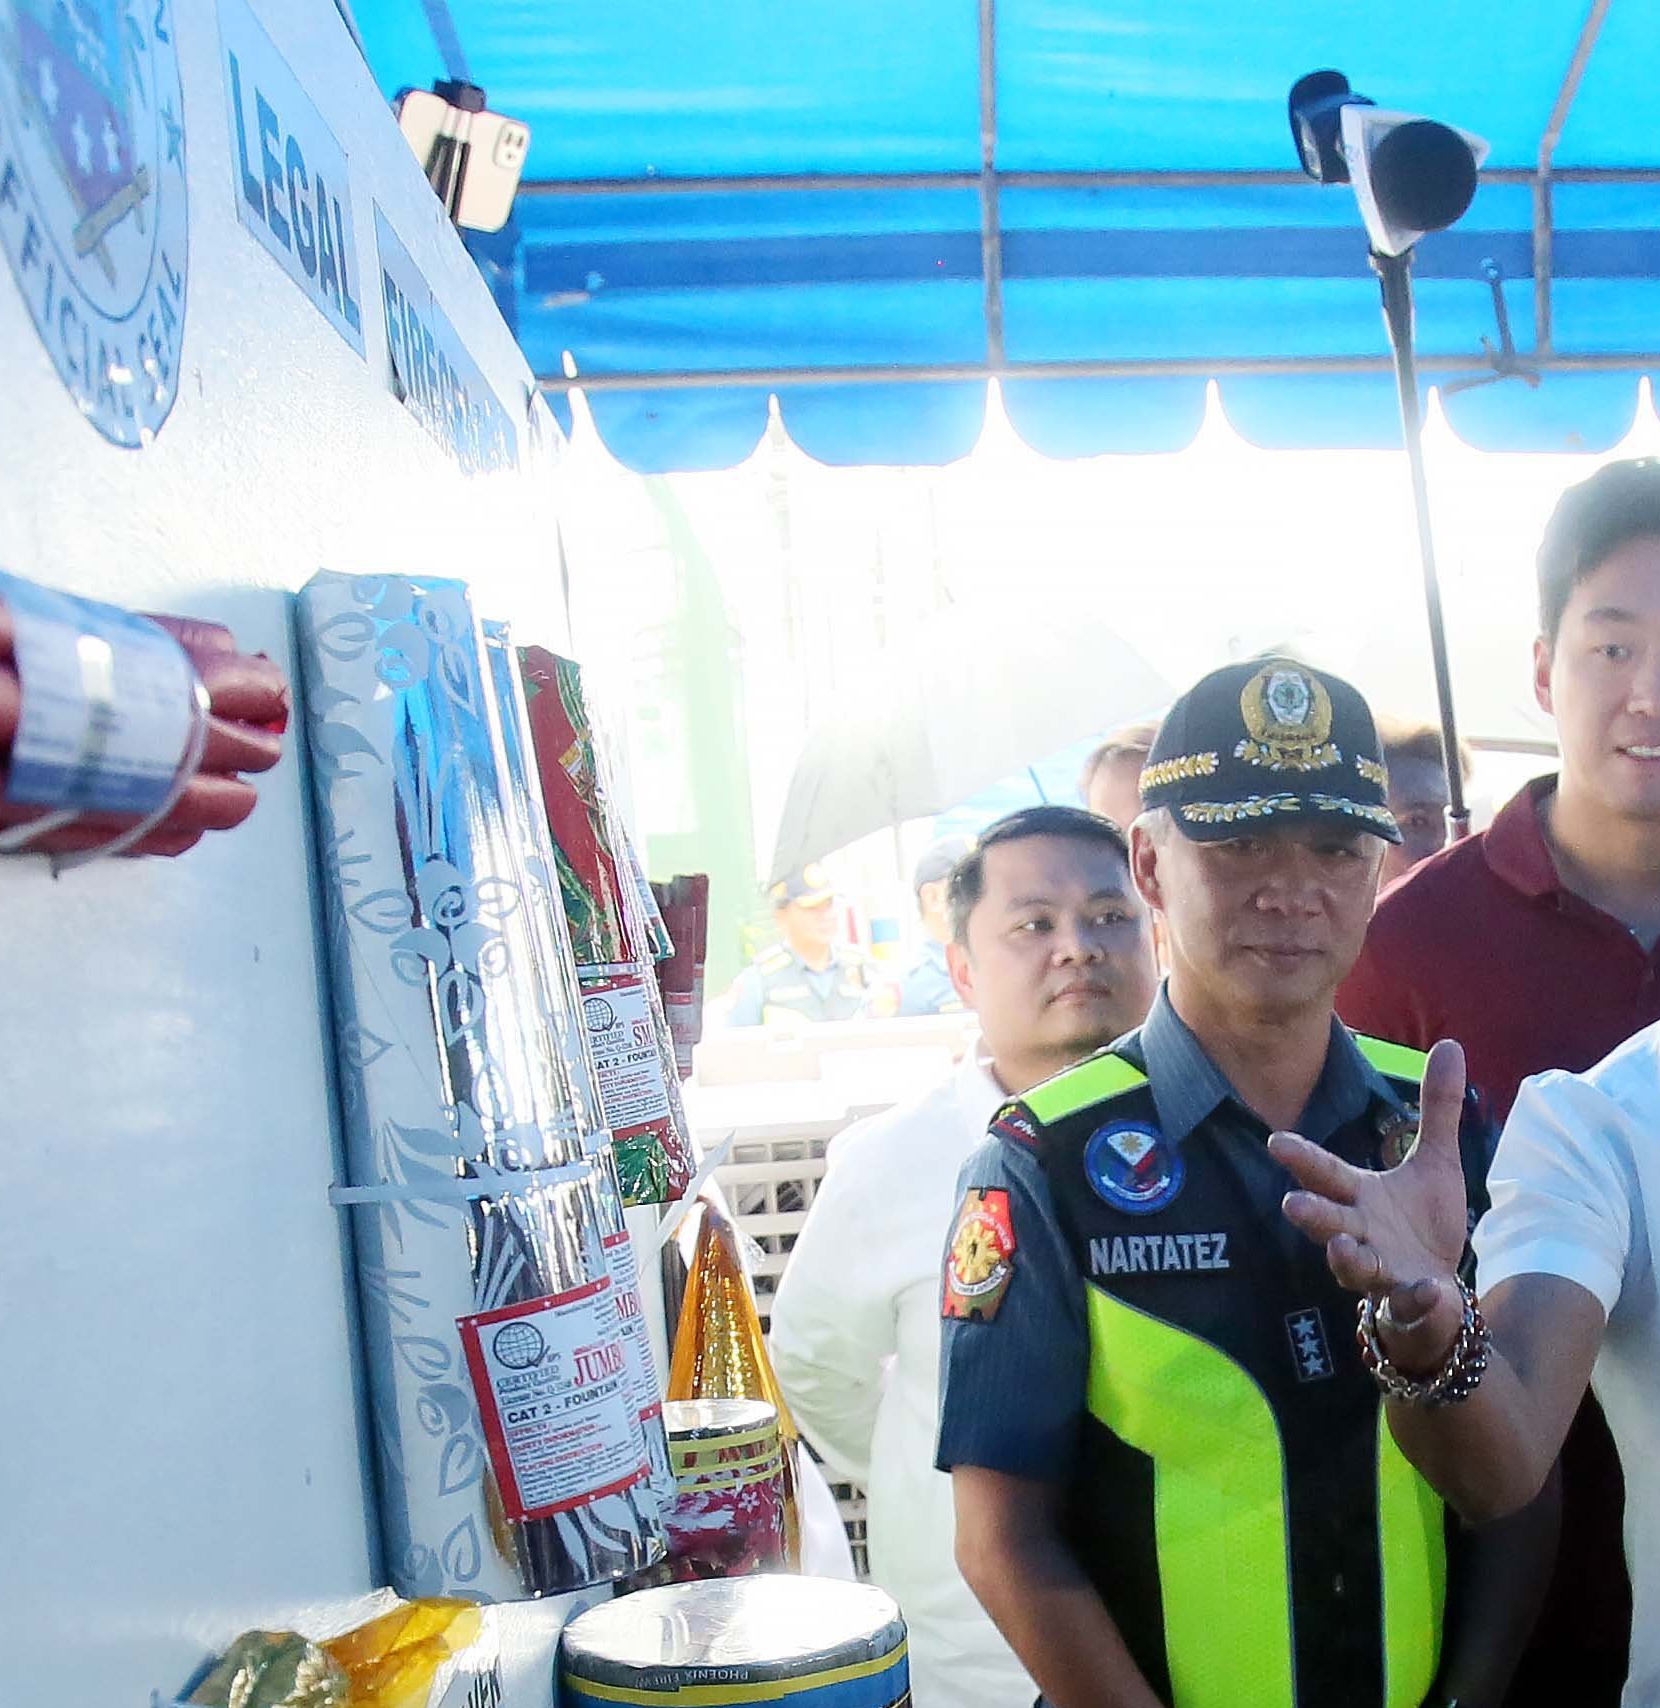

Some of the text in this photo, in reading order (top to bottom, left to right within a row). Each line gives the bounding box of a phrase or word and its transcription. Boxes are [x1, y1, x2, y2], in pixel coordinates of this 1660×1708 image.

[228, 47, 361, 336] LEGAL
[1089, 1232, 1230, 1276] NARTATEZ
[507, 1405, 538, 1424] CAT
[543, 1403, 552, 1415] 2
[565, 1381, 618, 1408] FOUNTAIN
[684, 1669, 749, 1681] PHOENIX
